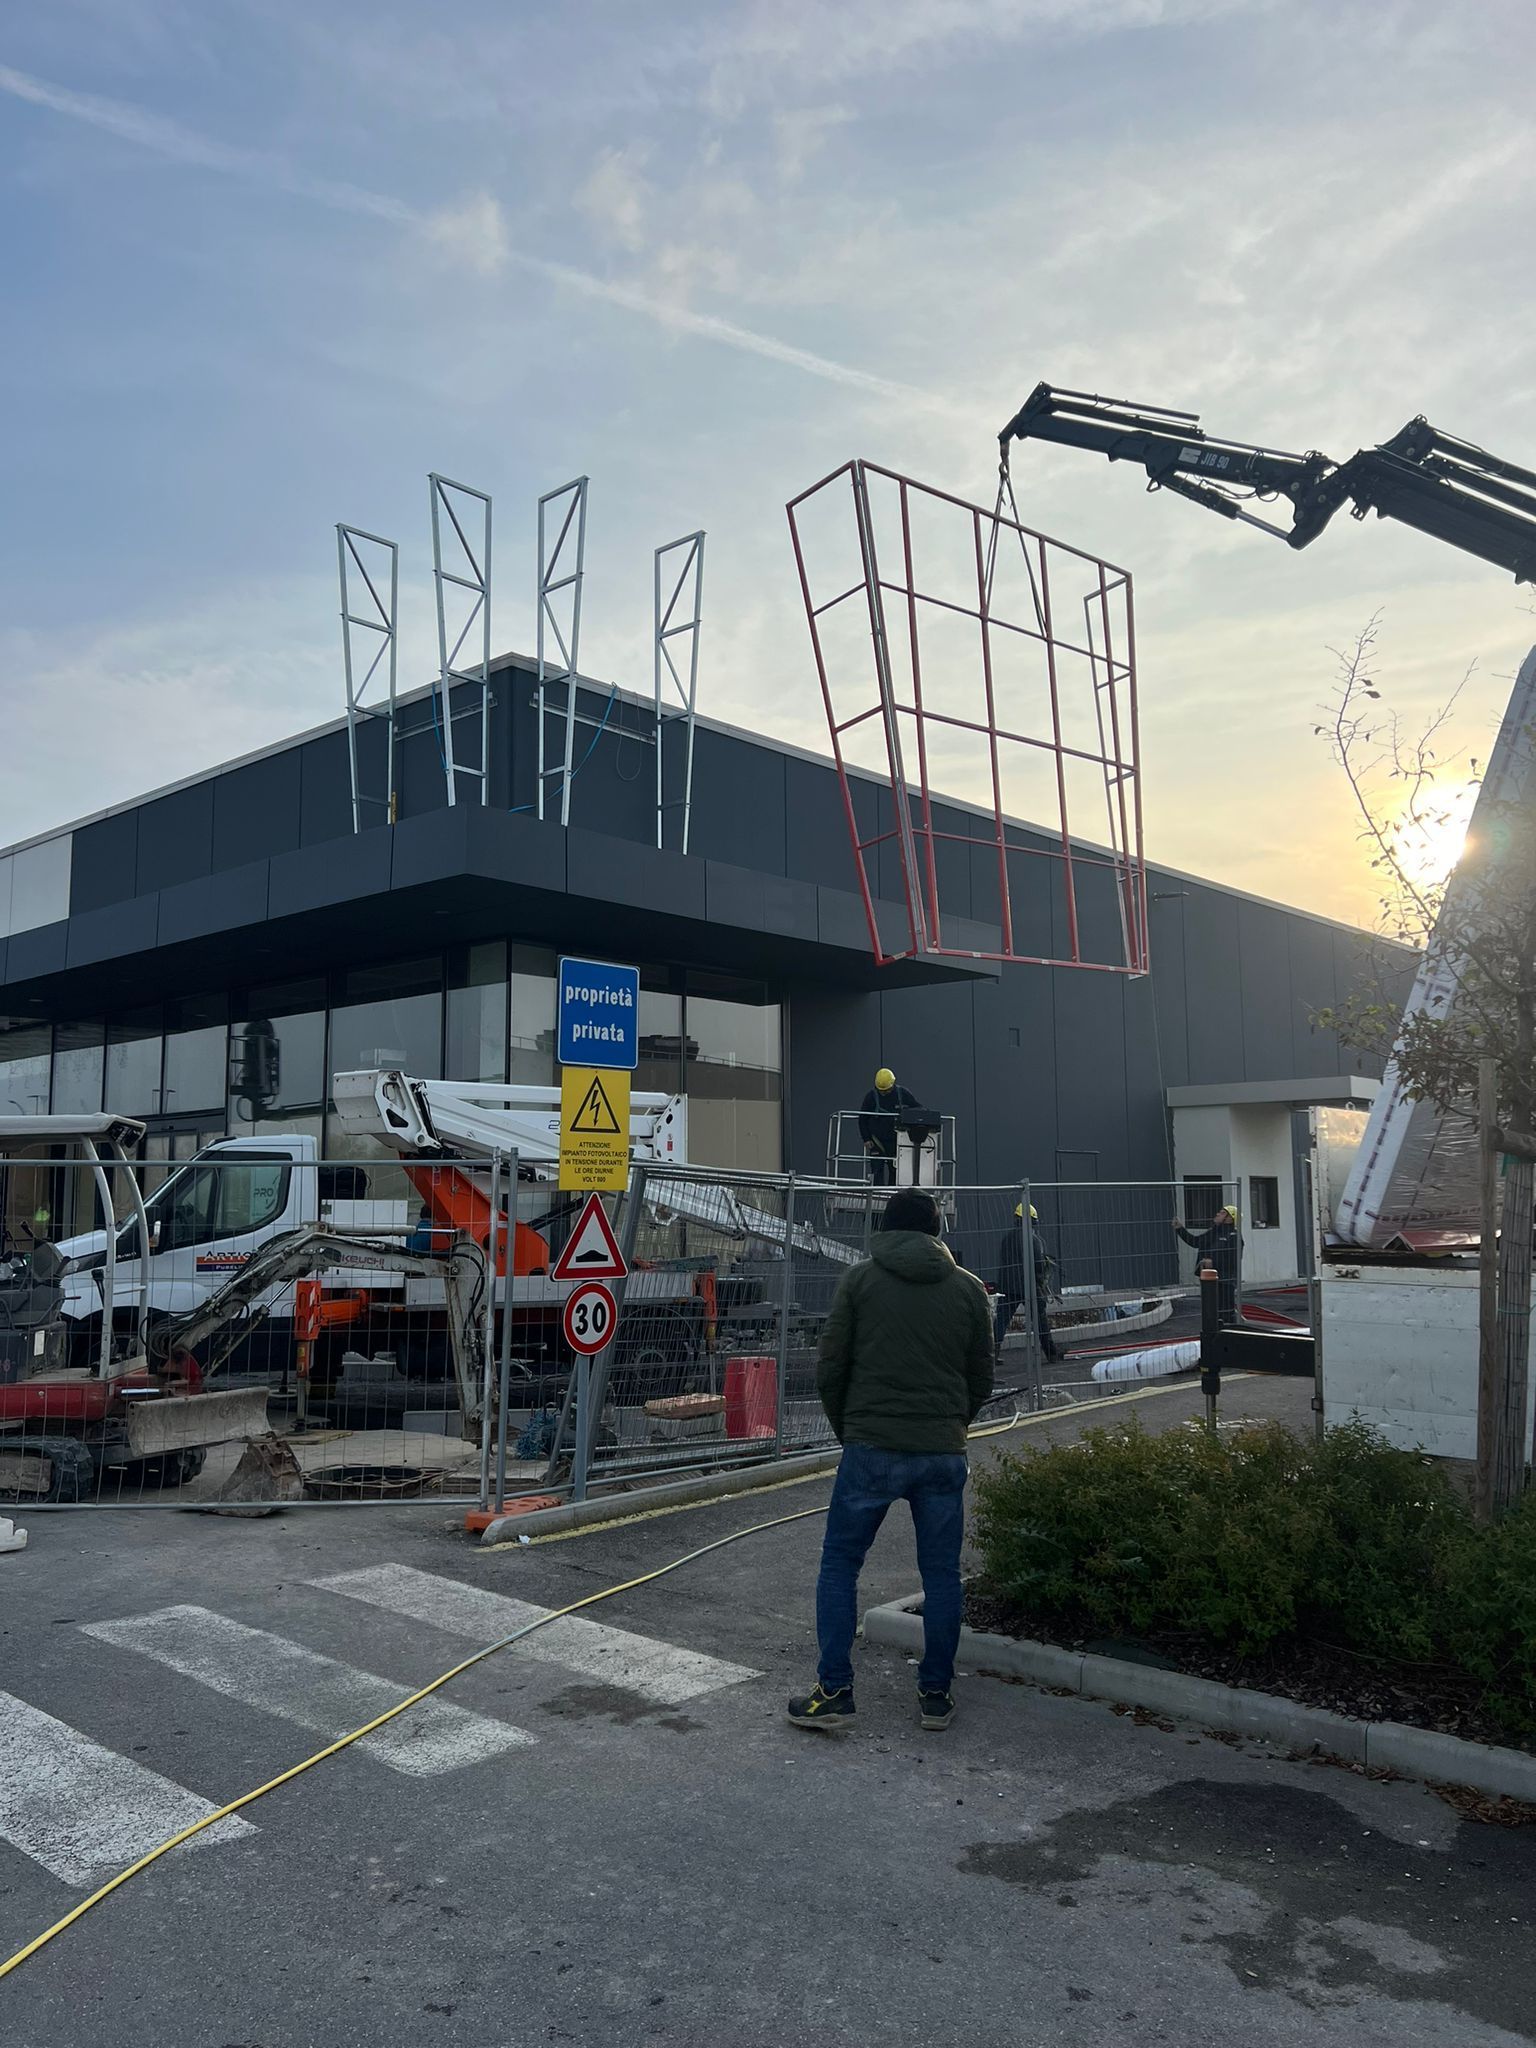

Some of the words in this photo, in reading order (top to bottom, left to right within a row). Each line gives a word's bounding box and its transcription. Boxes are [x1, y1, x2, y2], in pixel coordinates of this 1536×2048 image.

[1200, 452, 1217, 467] JIB
[565, 985, 633, 1007] proprietà
[572, 1020, 625, 1042] privata
[575, 1302, 606, 1335] 30
